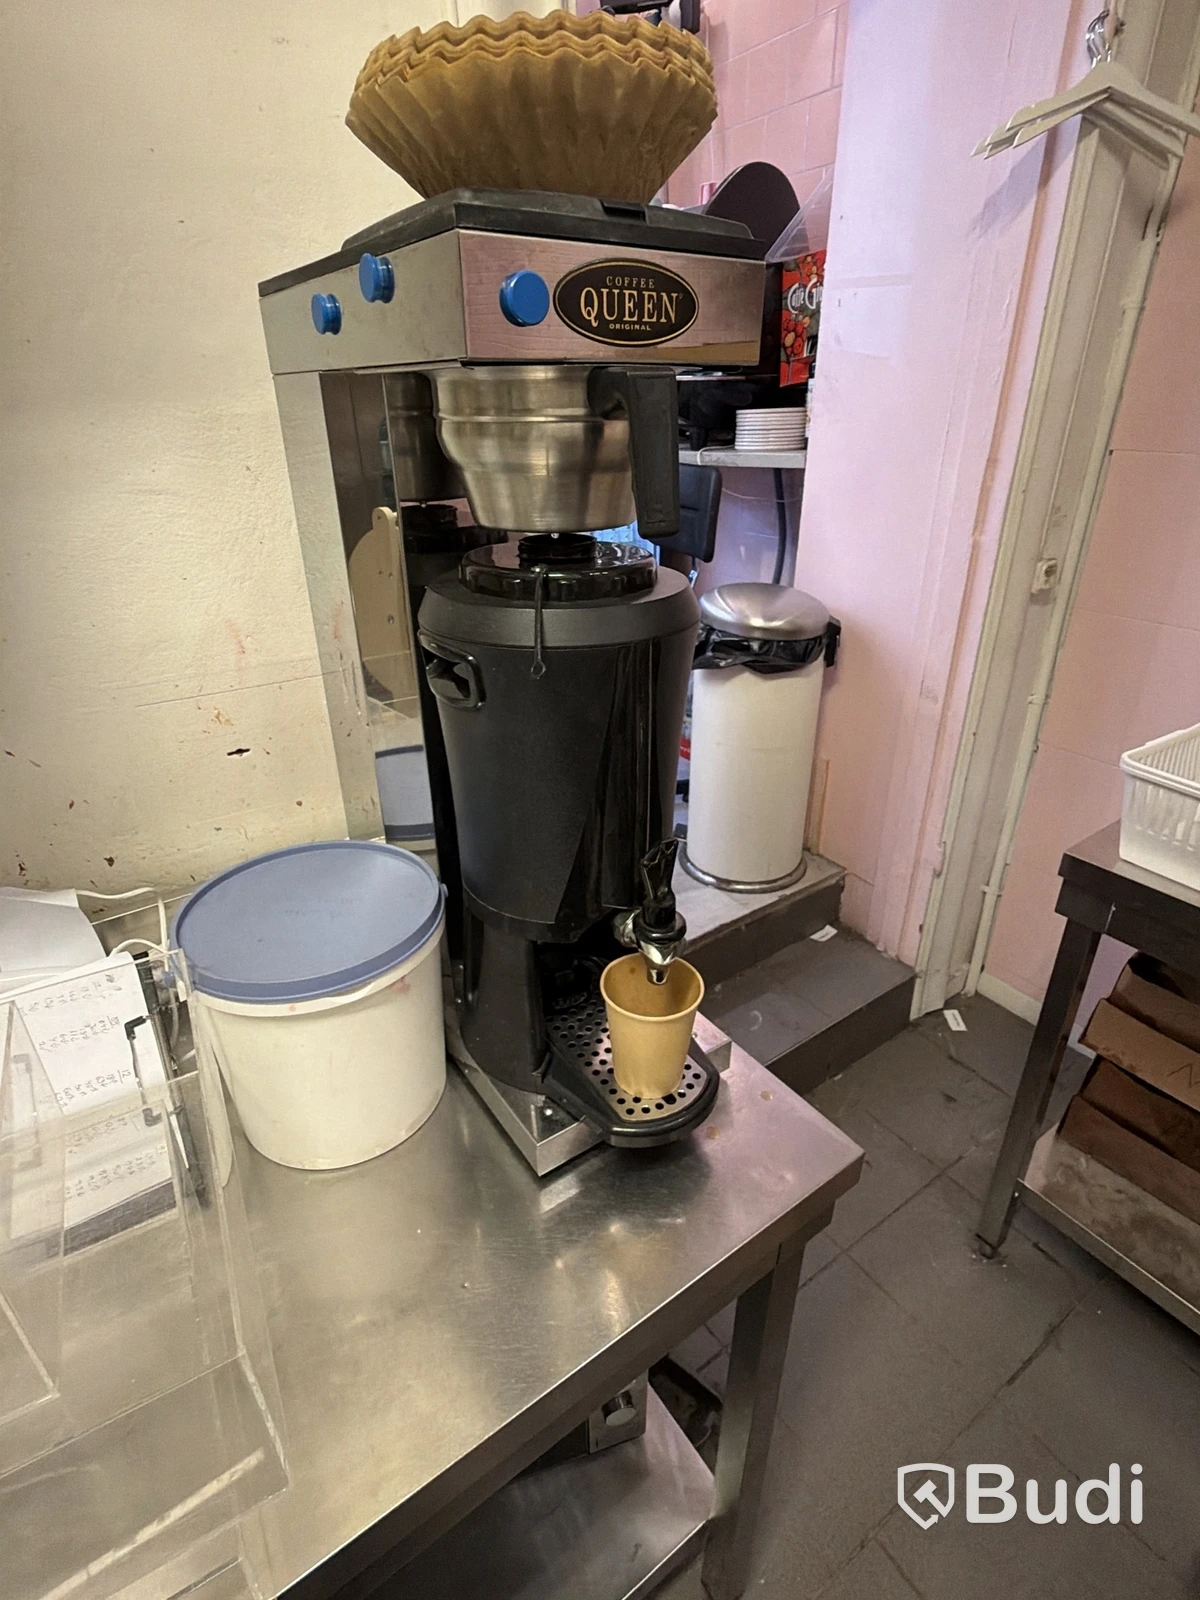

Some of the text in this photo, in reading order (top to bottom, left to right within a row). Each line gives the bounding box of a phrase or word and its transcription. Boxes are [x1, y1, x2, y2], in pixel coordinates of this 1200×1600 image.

[606, 276, 655, 289] COFFEE
[580, 287, 678, 327] QUEEN
[609, 323, 651, 331] ORIGINAL
